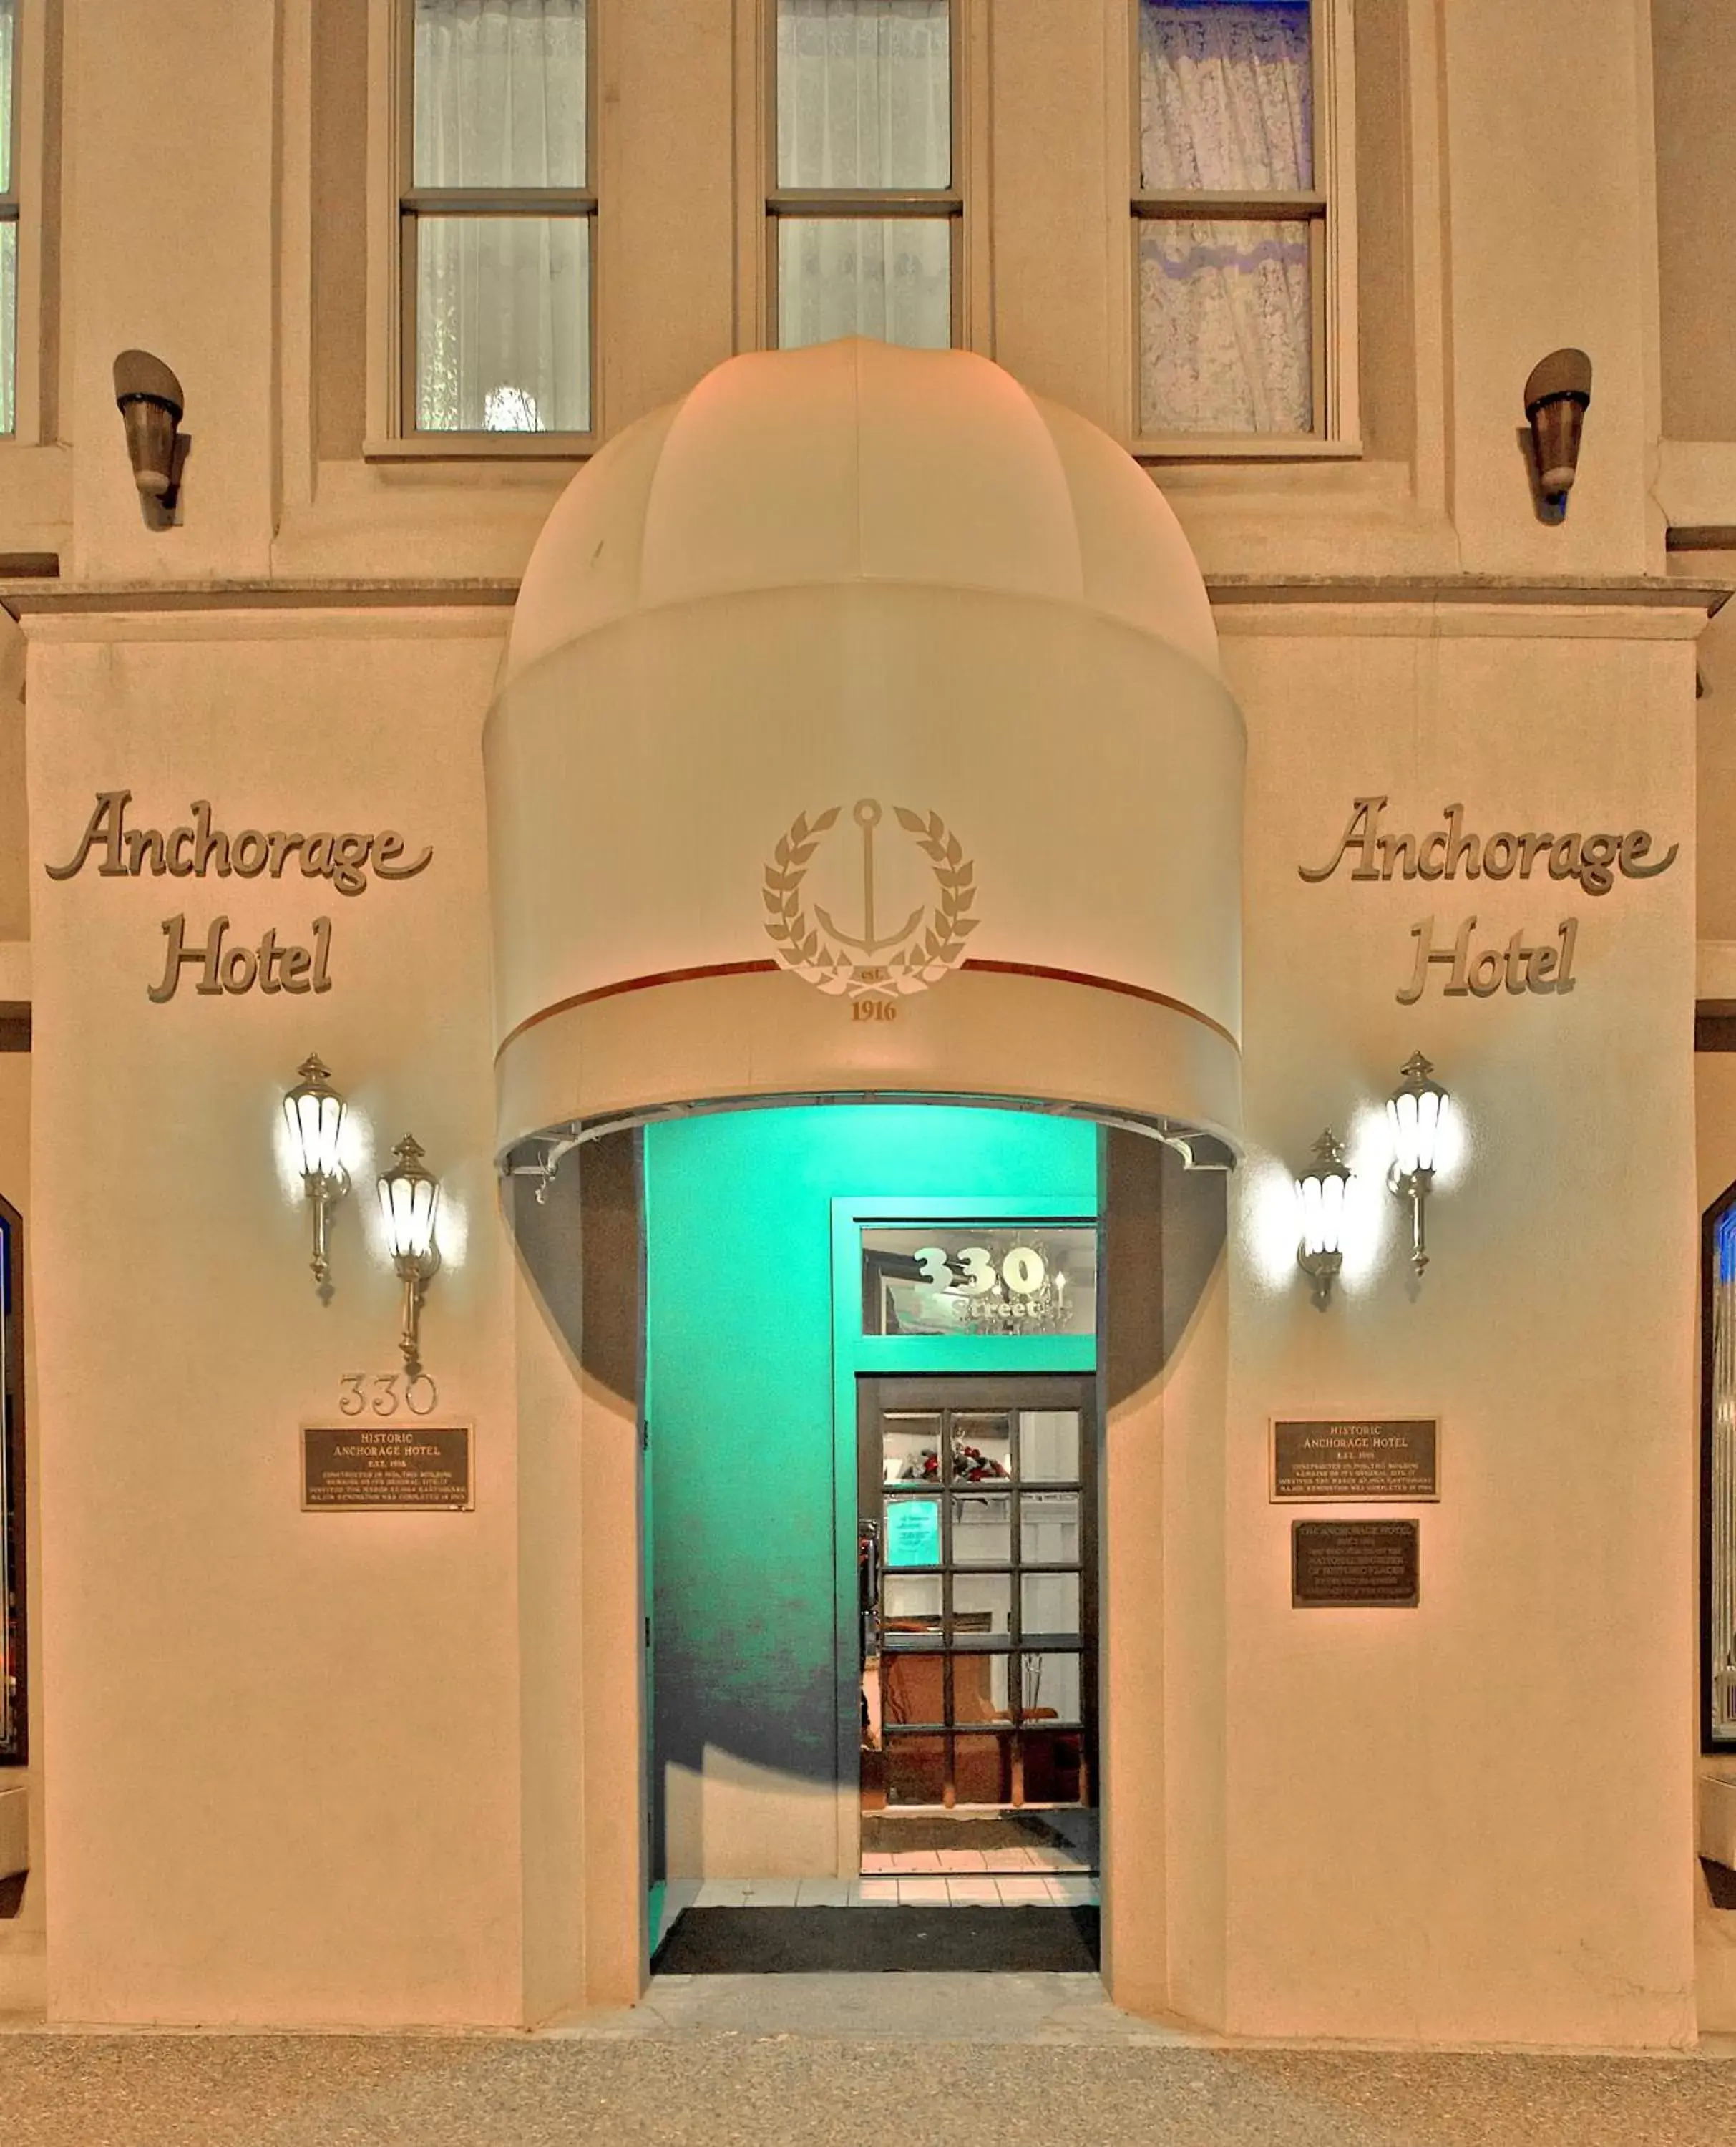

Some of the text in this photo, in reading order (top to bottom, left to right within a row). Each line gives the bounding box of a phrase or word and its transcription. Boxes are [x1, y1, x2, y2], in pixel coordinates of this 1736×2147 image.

[44, 789, 433, 897] Anchorage
[1298, 794, 1679, 896] Anchorage
[147, 914, 332, 1003] Hotel
[1395, 915, 1578, 1006] Hotel
[851, 1000, 897, 1022] 1916
[914, 1247, 1045, 1294] 330
[951, 1298, 1040, 1318] Street
[339, 1373, 438, 1416] 330
[361, 1433, 413, 1443] HISTORIC
[1303, 1438, 1409, 1449] ANCHORAGE HOTEL
[1330, 1426, 1382, 1435] HISTORIC
[333, 1446, 441, 1456] ANCHORAGE HOTEL
